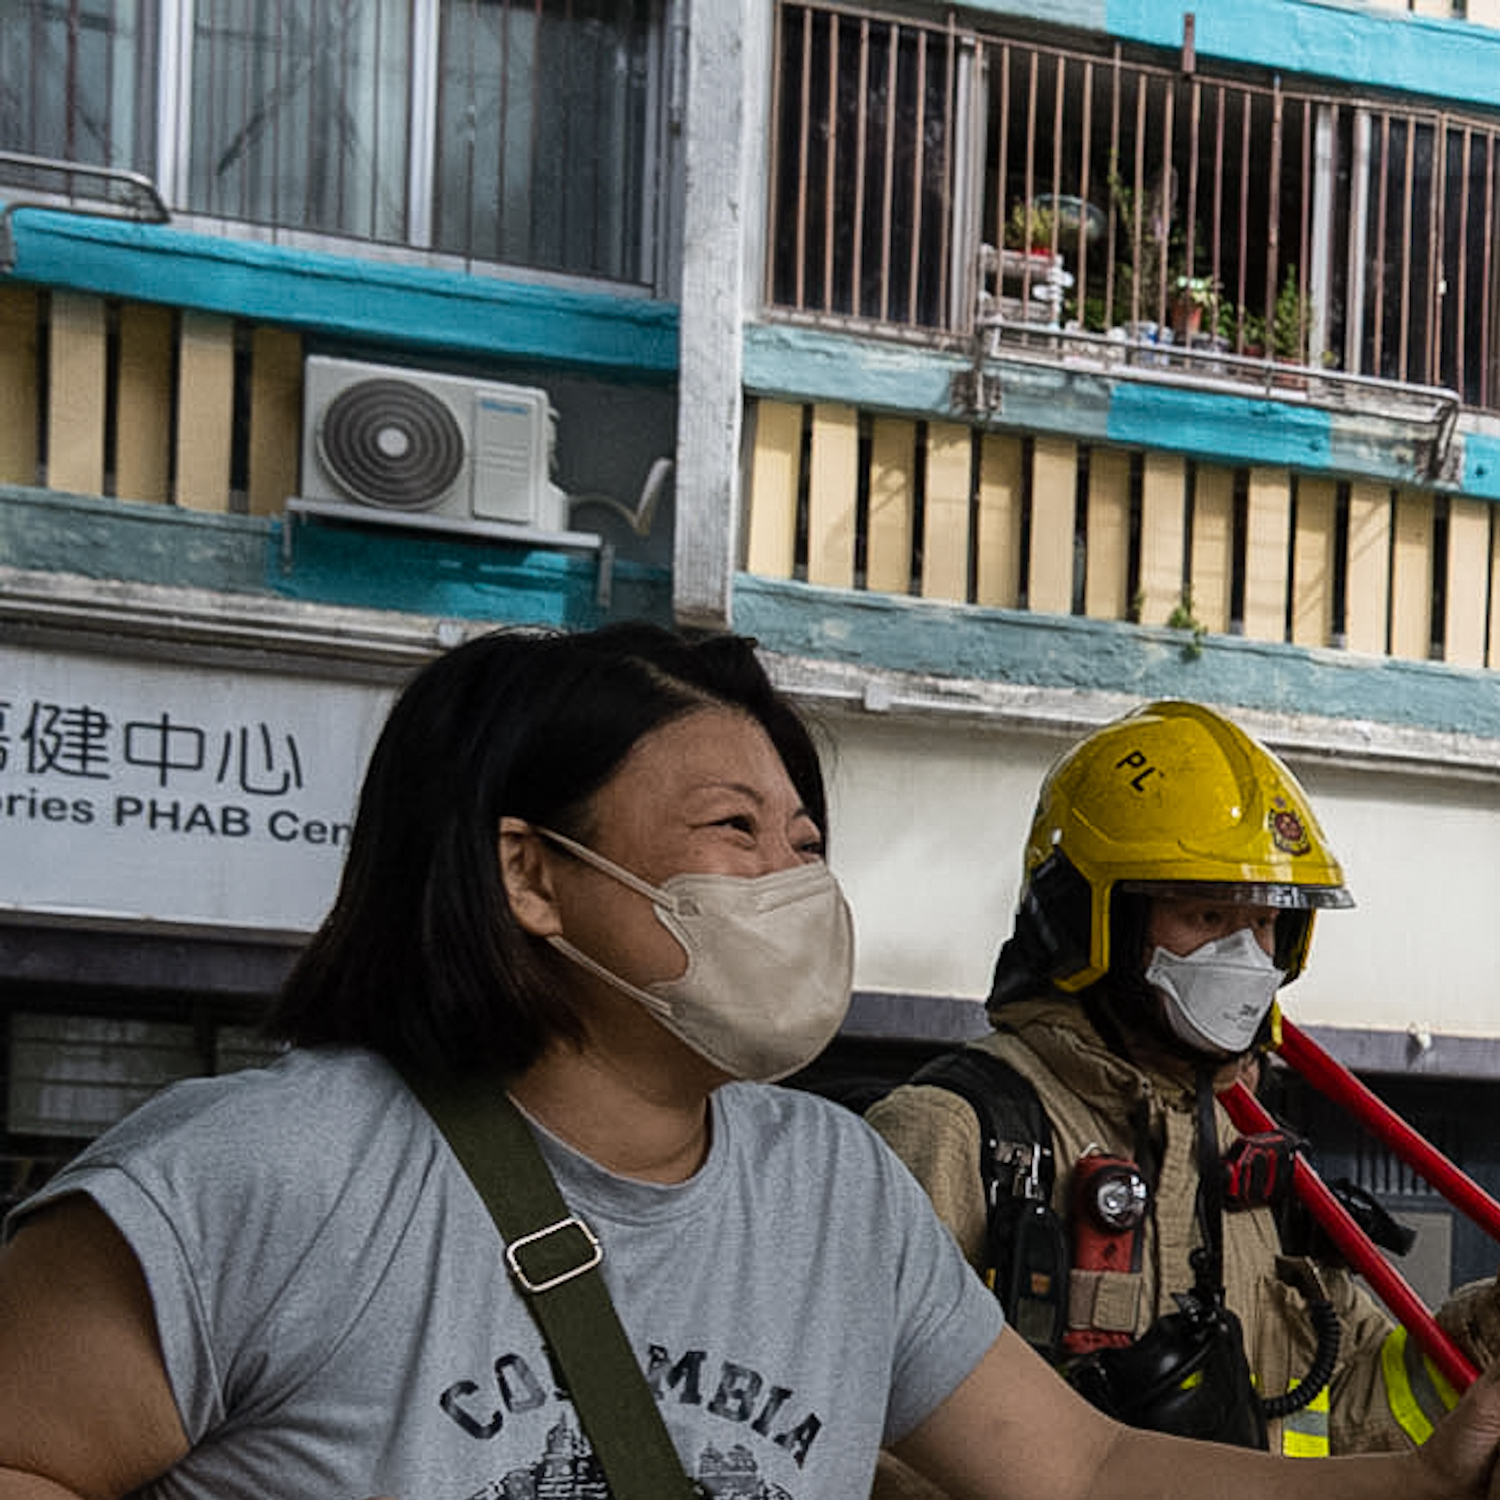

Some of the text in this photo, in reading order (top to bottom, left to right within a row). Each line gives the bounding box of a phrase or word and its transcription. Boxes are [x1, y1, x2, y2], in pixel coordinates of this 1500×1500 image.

[0, 699, 303, 796] 健中心
[0, 787, 353, 846] ries PHAB Cen
[440, 1344, 822, 1469] COMBIA
